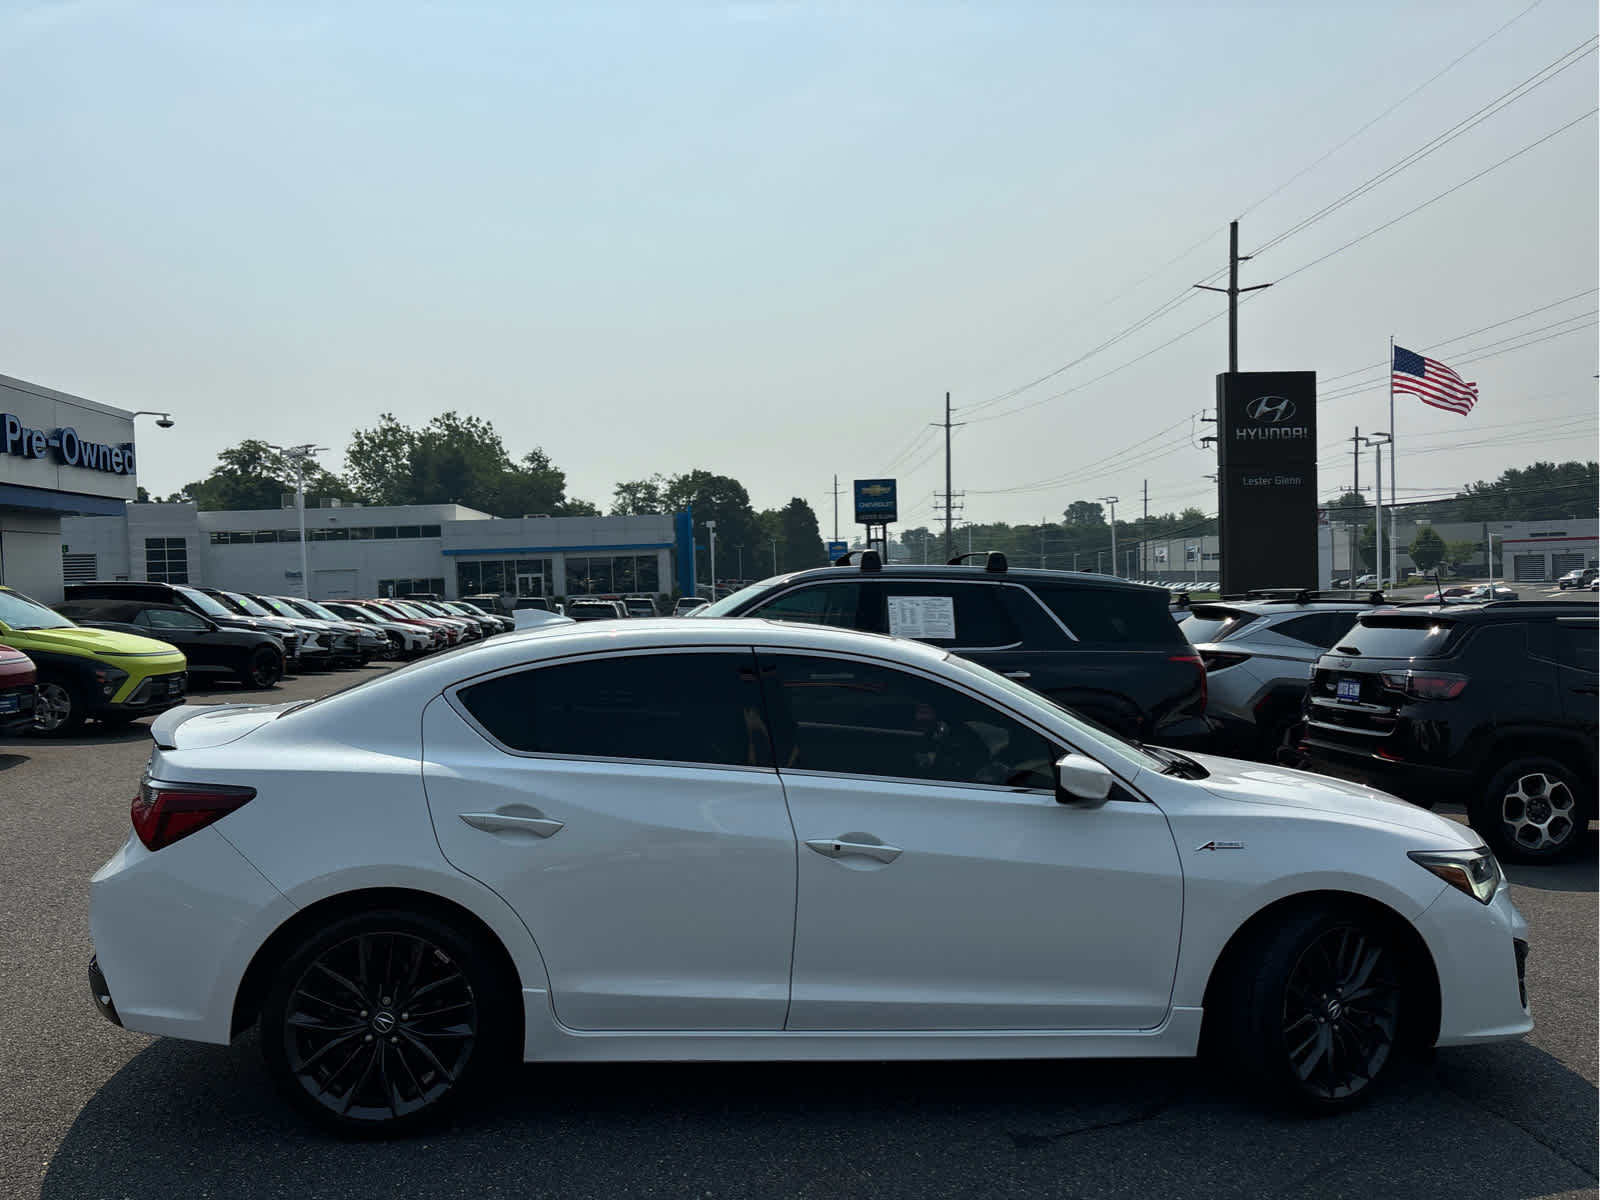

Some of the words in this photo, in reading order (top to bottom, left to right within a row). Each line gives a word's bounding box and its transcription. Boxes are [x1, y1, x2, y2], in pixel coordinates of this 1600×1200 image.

[1236, 427, 1307, 440] HYUNDAI
[3, 413, 135, 474] Pre-Owned
[1242, 475, 1272, 486] Lester
